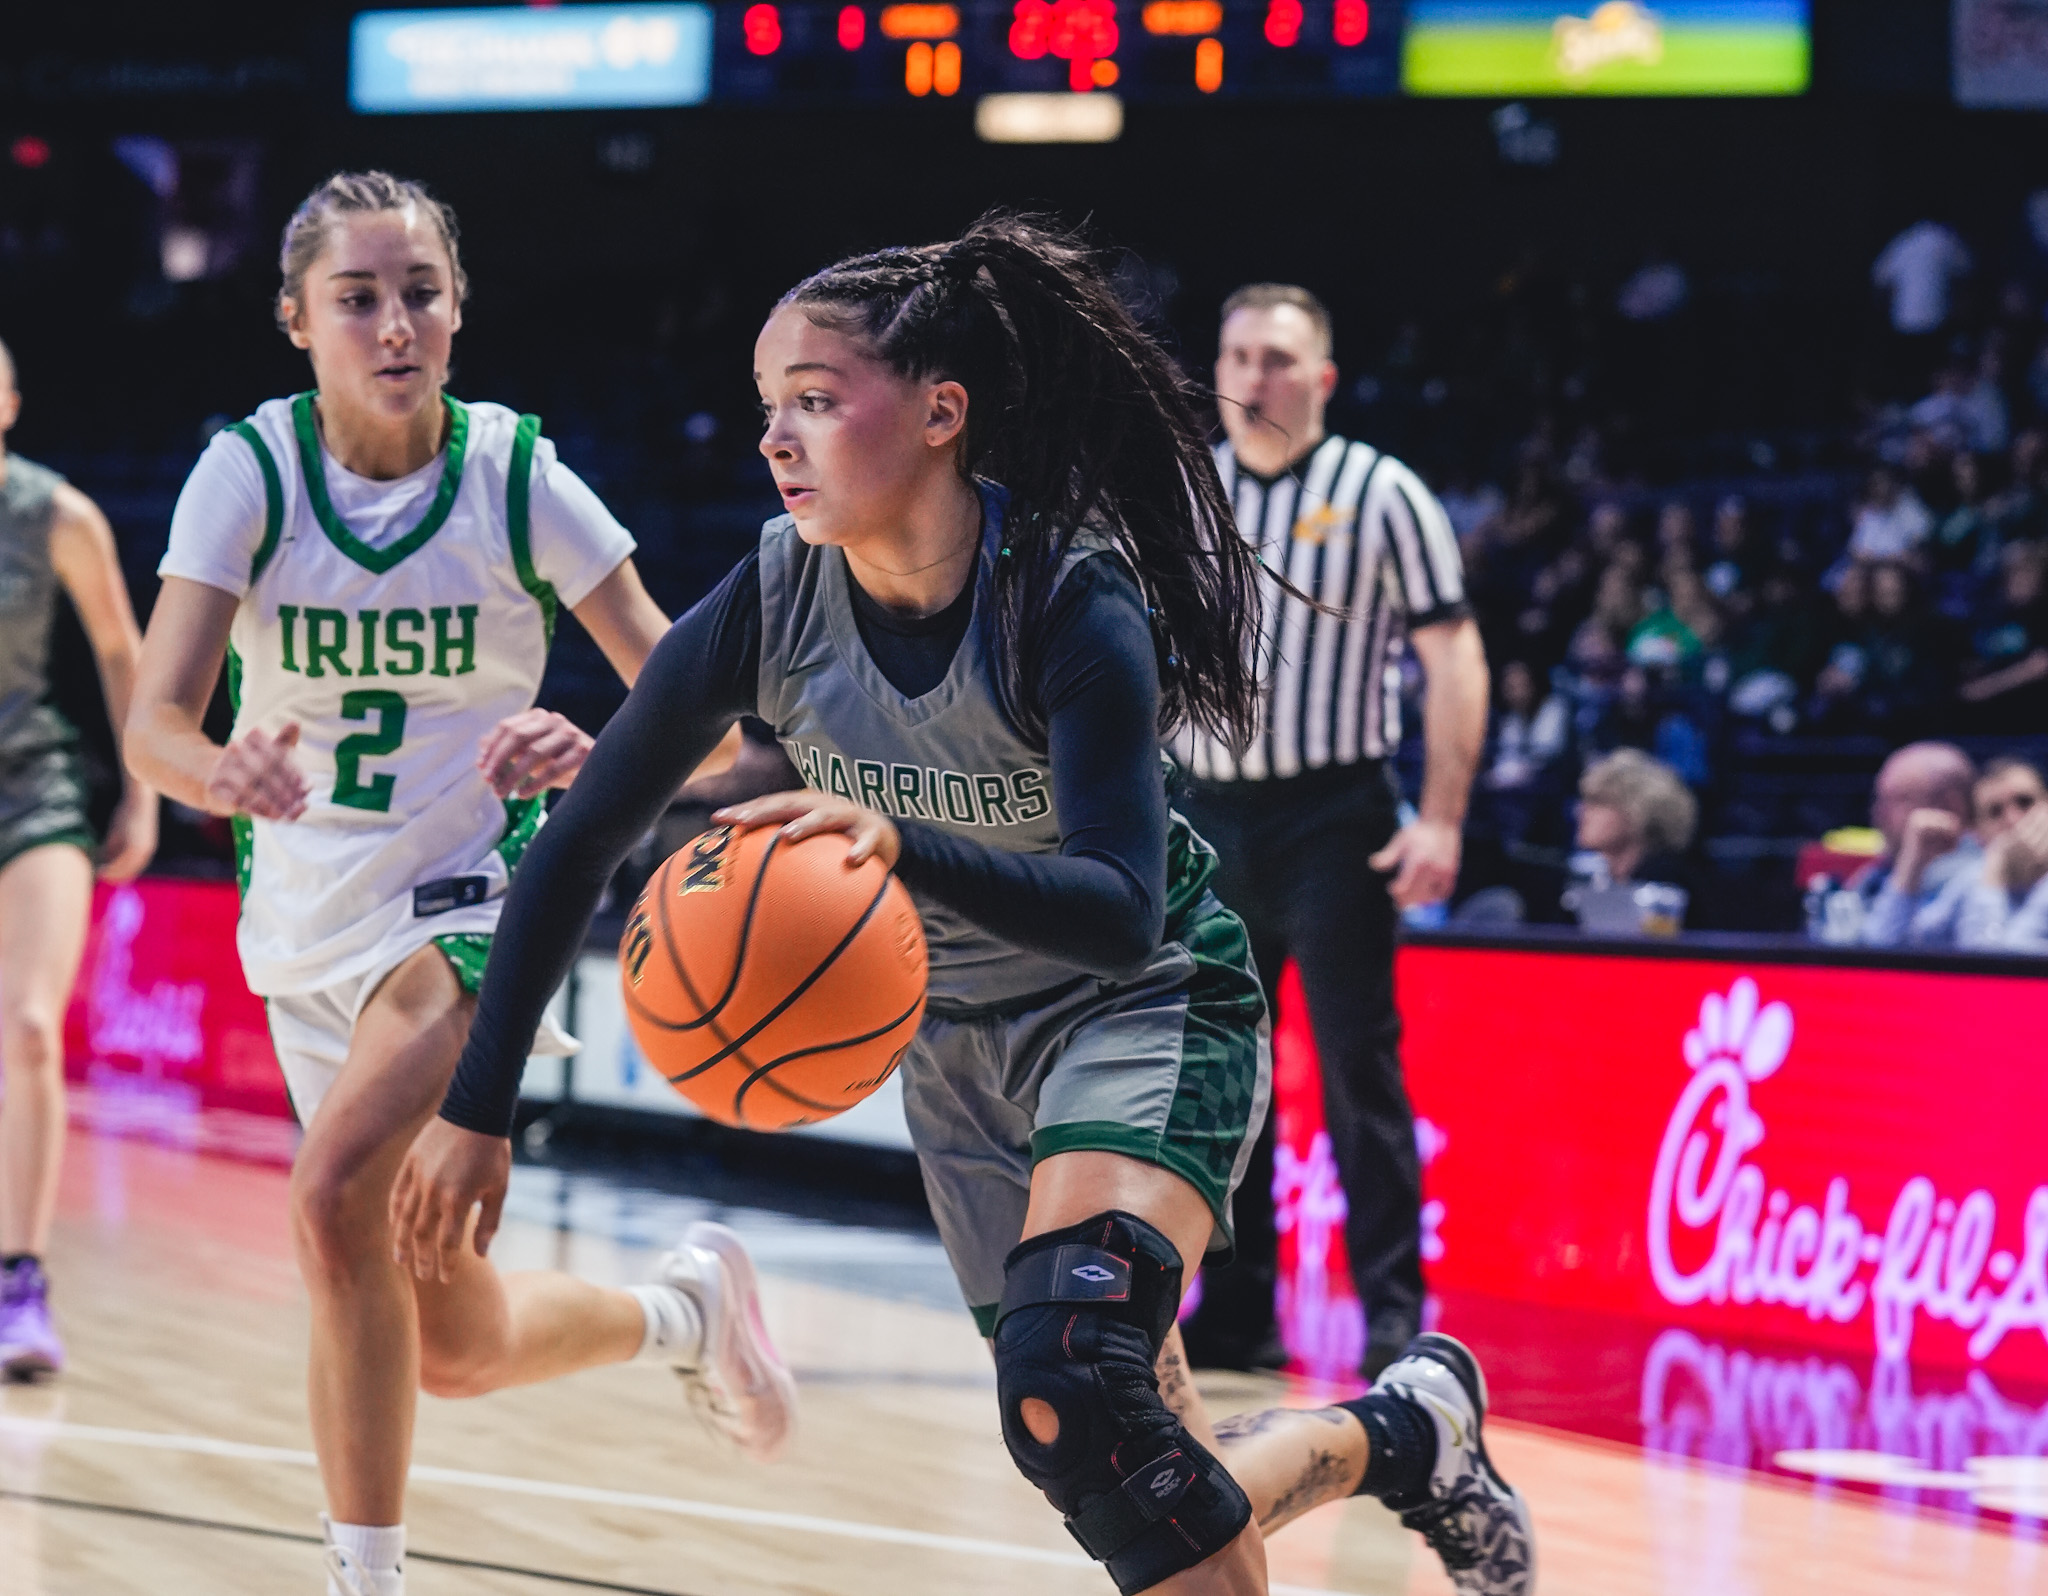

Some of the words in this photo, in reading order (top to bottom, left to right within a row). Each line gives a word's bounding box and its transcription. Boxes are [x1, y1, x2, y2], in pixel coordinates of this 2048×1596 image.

[278, 604, 479, 678] IRISH
[331, 689, 407, 813] 2
[788, 740, 1051, 827] WARRIORS
